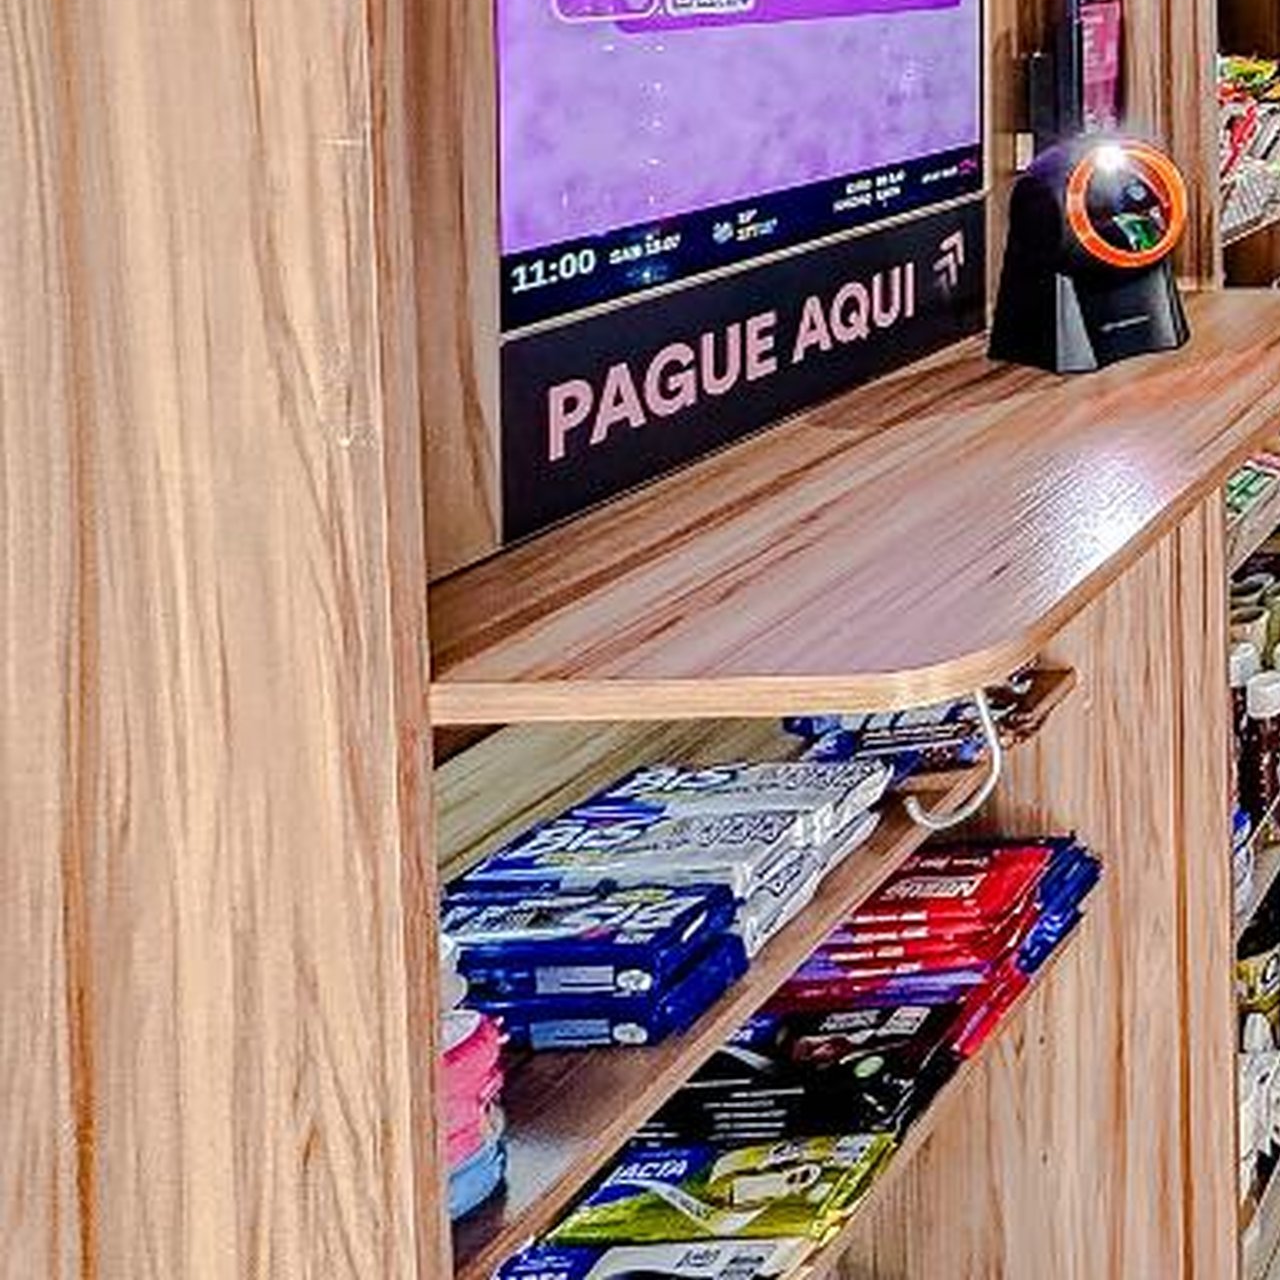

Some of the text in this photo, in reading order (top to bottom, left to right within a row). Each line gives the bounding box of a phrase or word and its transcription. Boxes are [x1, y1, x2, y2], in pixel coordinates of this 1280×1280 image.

[510, 247, 598, 294] 11:00
[547, 261, 916, 462] PAGUE AQUI
